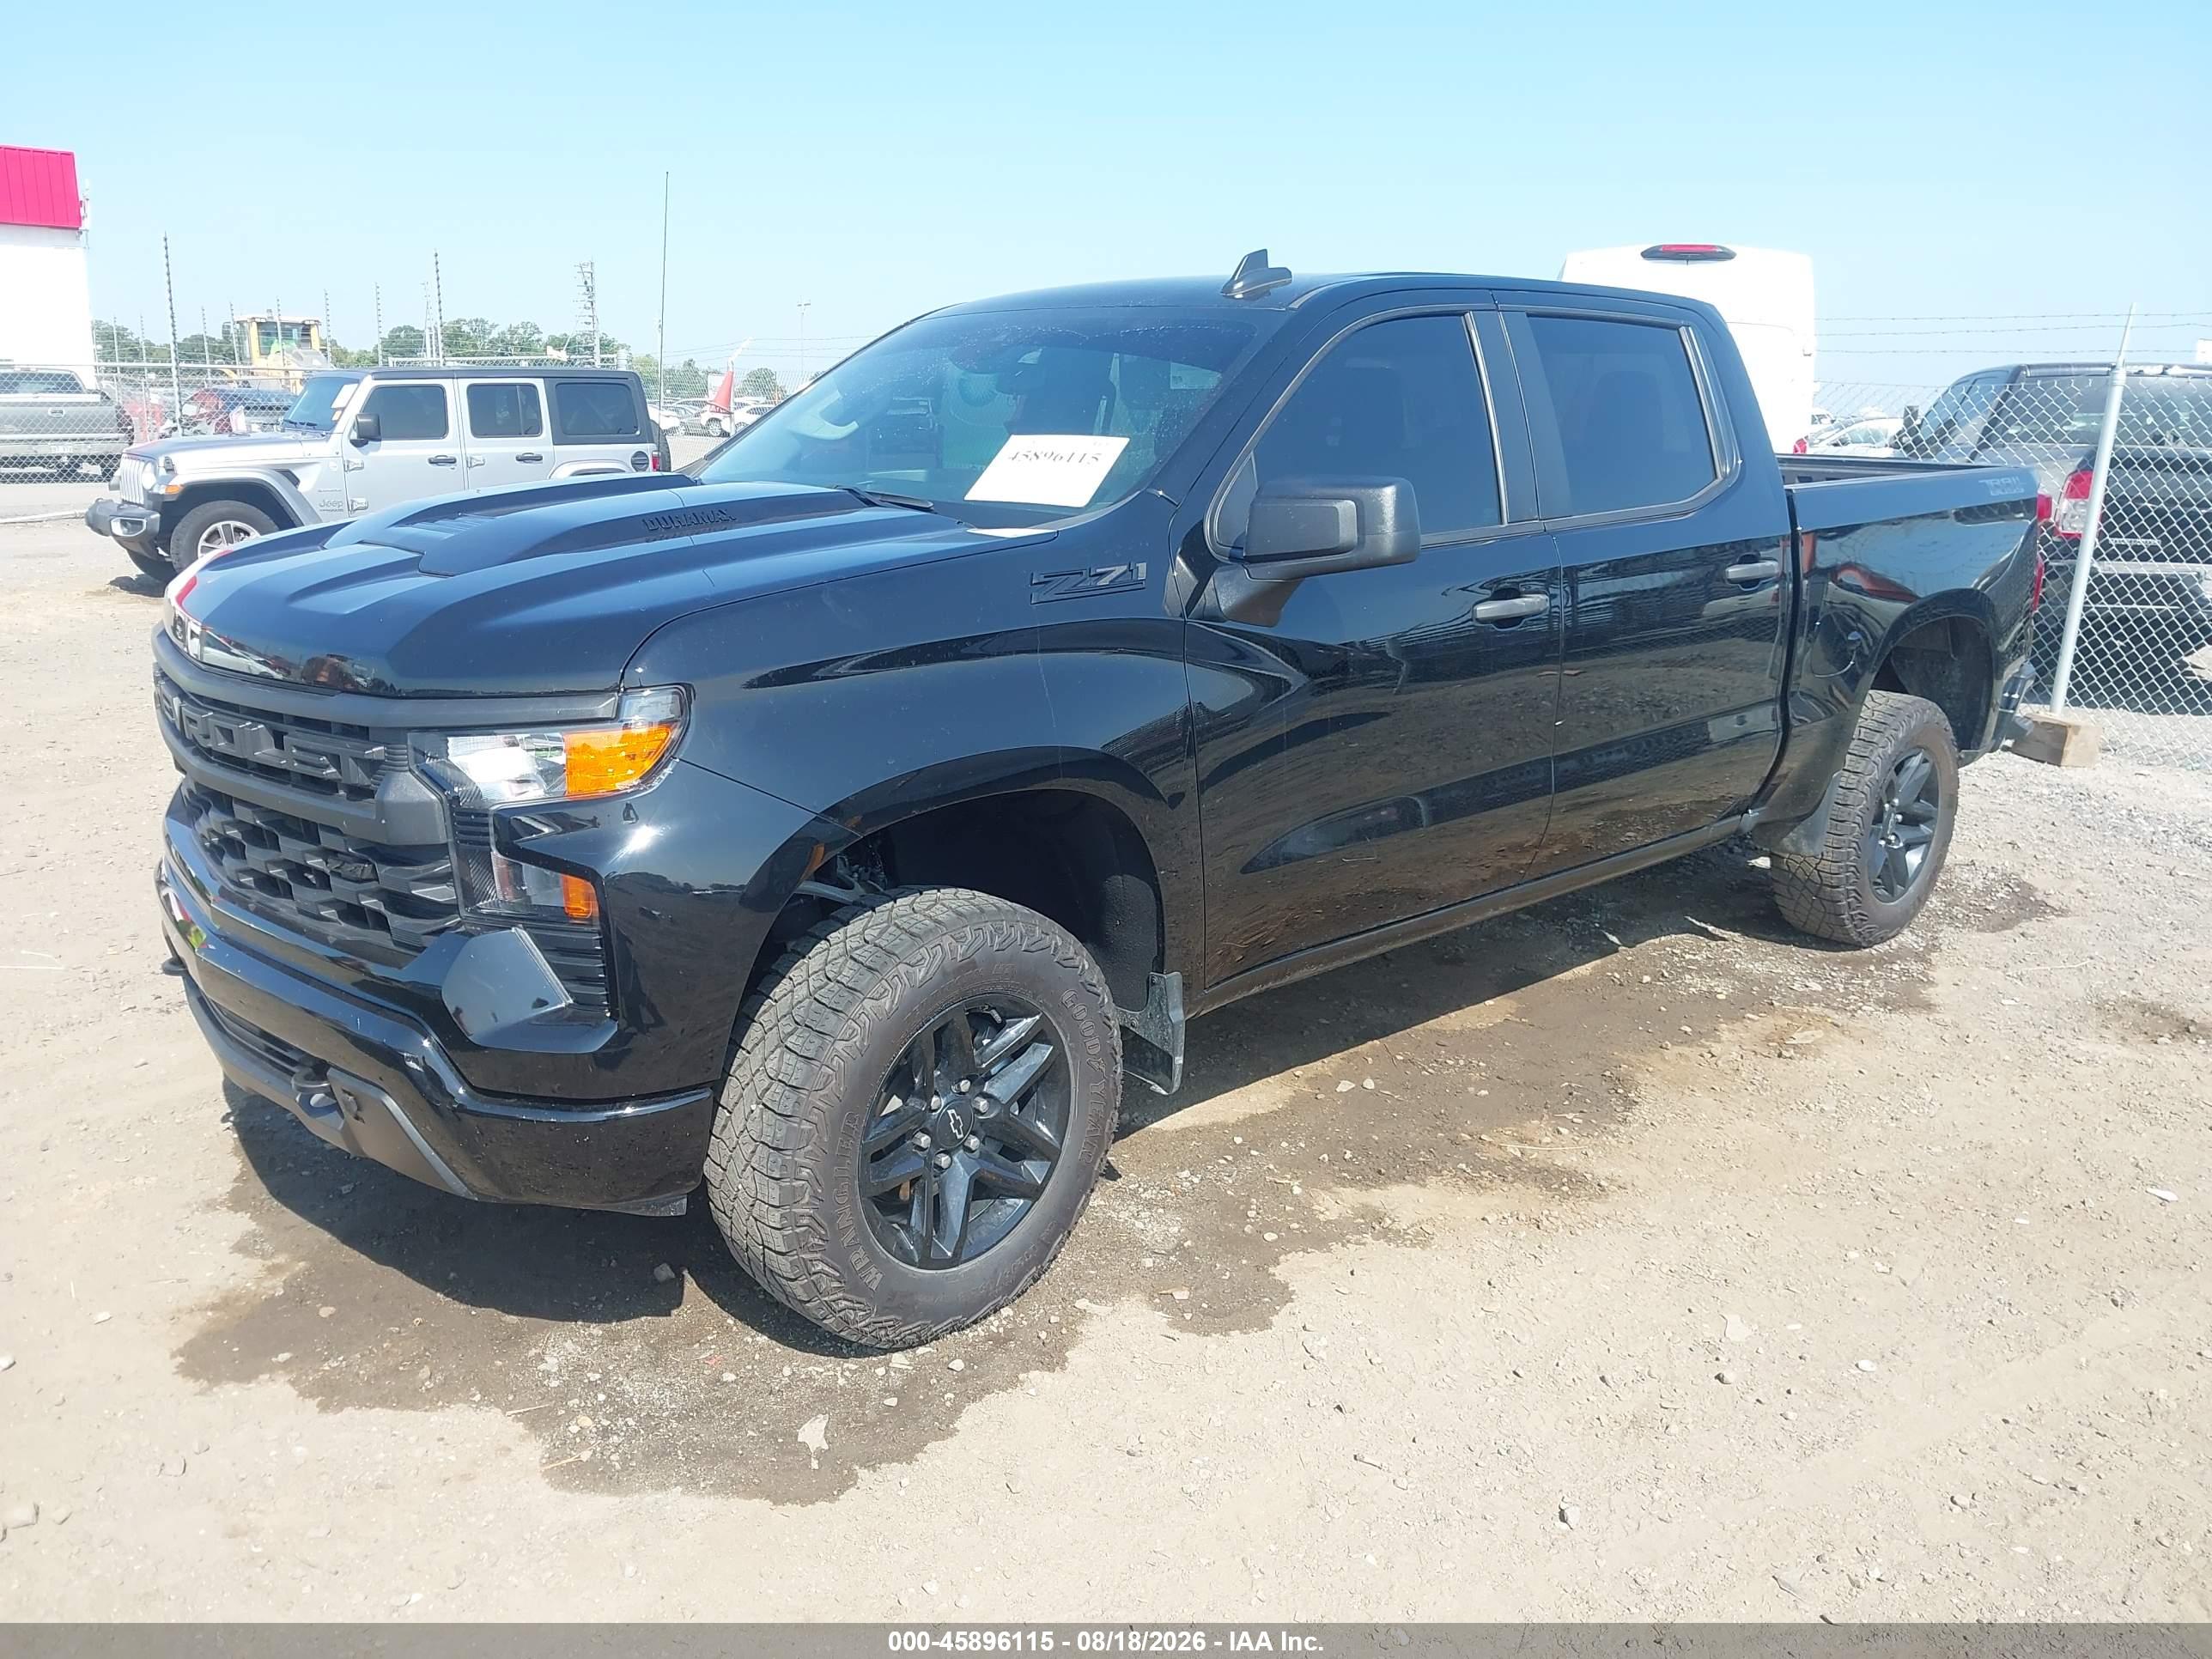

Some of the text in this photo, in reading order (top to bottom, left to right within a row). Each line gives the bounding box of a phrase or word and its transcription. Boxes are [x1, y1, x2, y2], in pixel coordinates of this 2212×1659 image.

[1008, 449, 1103, 465] 45896115
[318, 498, 342, 507] Jeep
[642, 508, 738, 532] DURAMAX
[1030, 562, 1147, 605] Z71
[154, 681, 385, 786] EVROLET
[833, 1111, 885, 1292] WRANGLER
